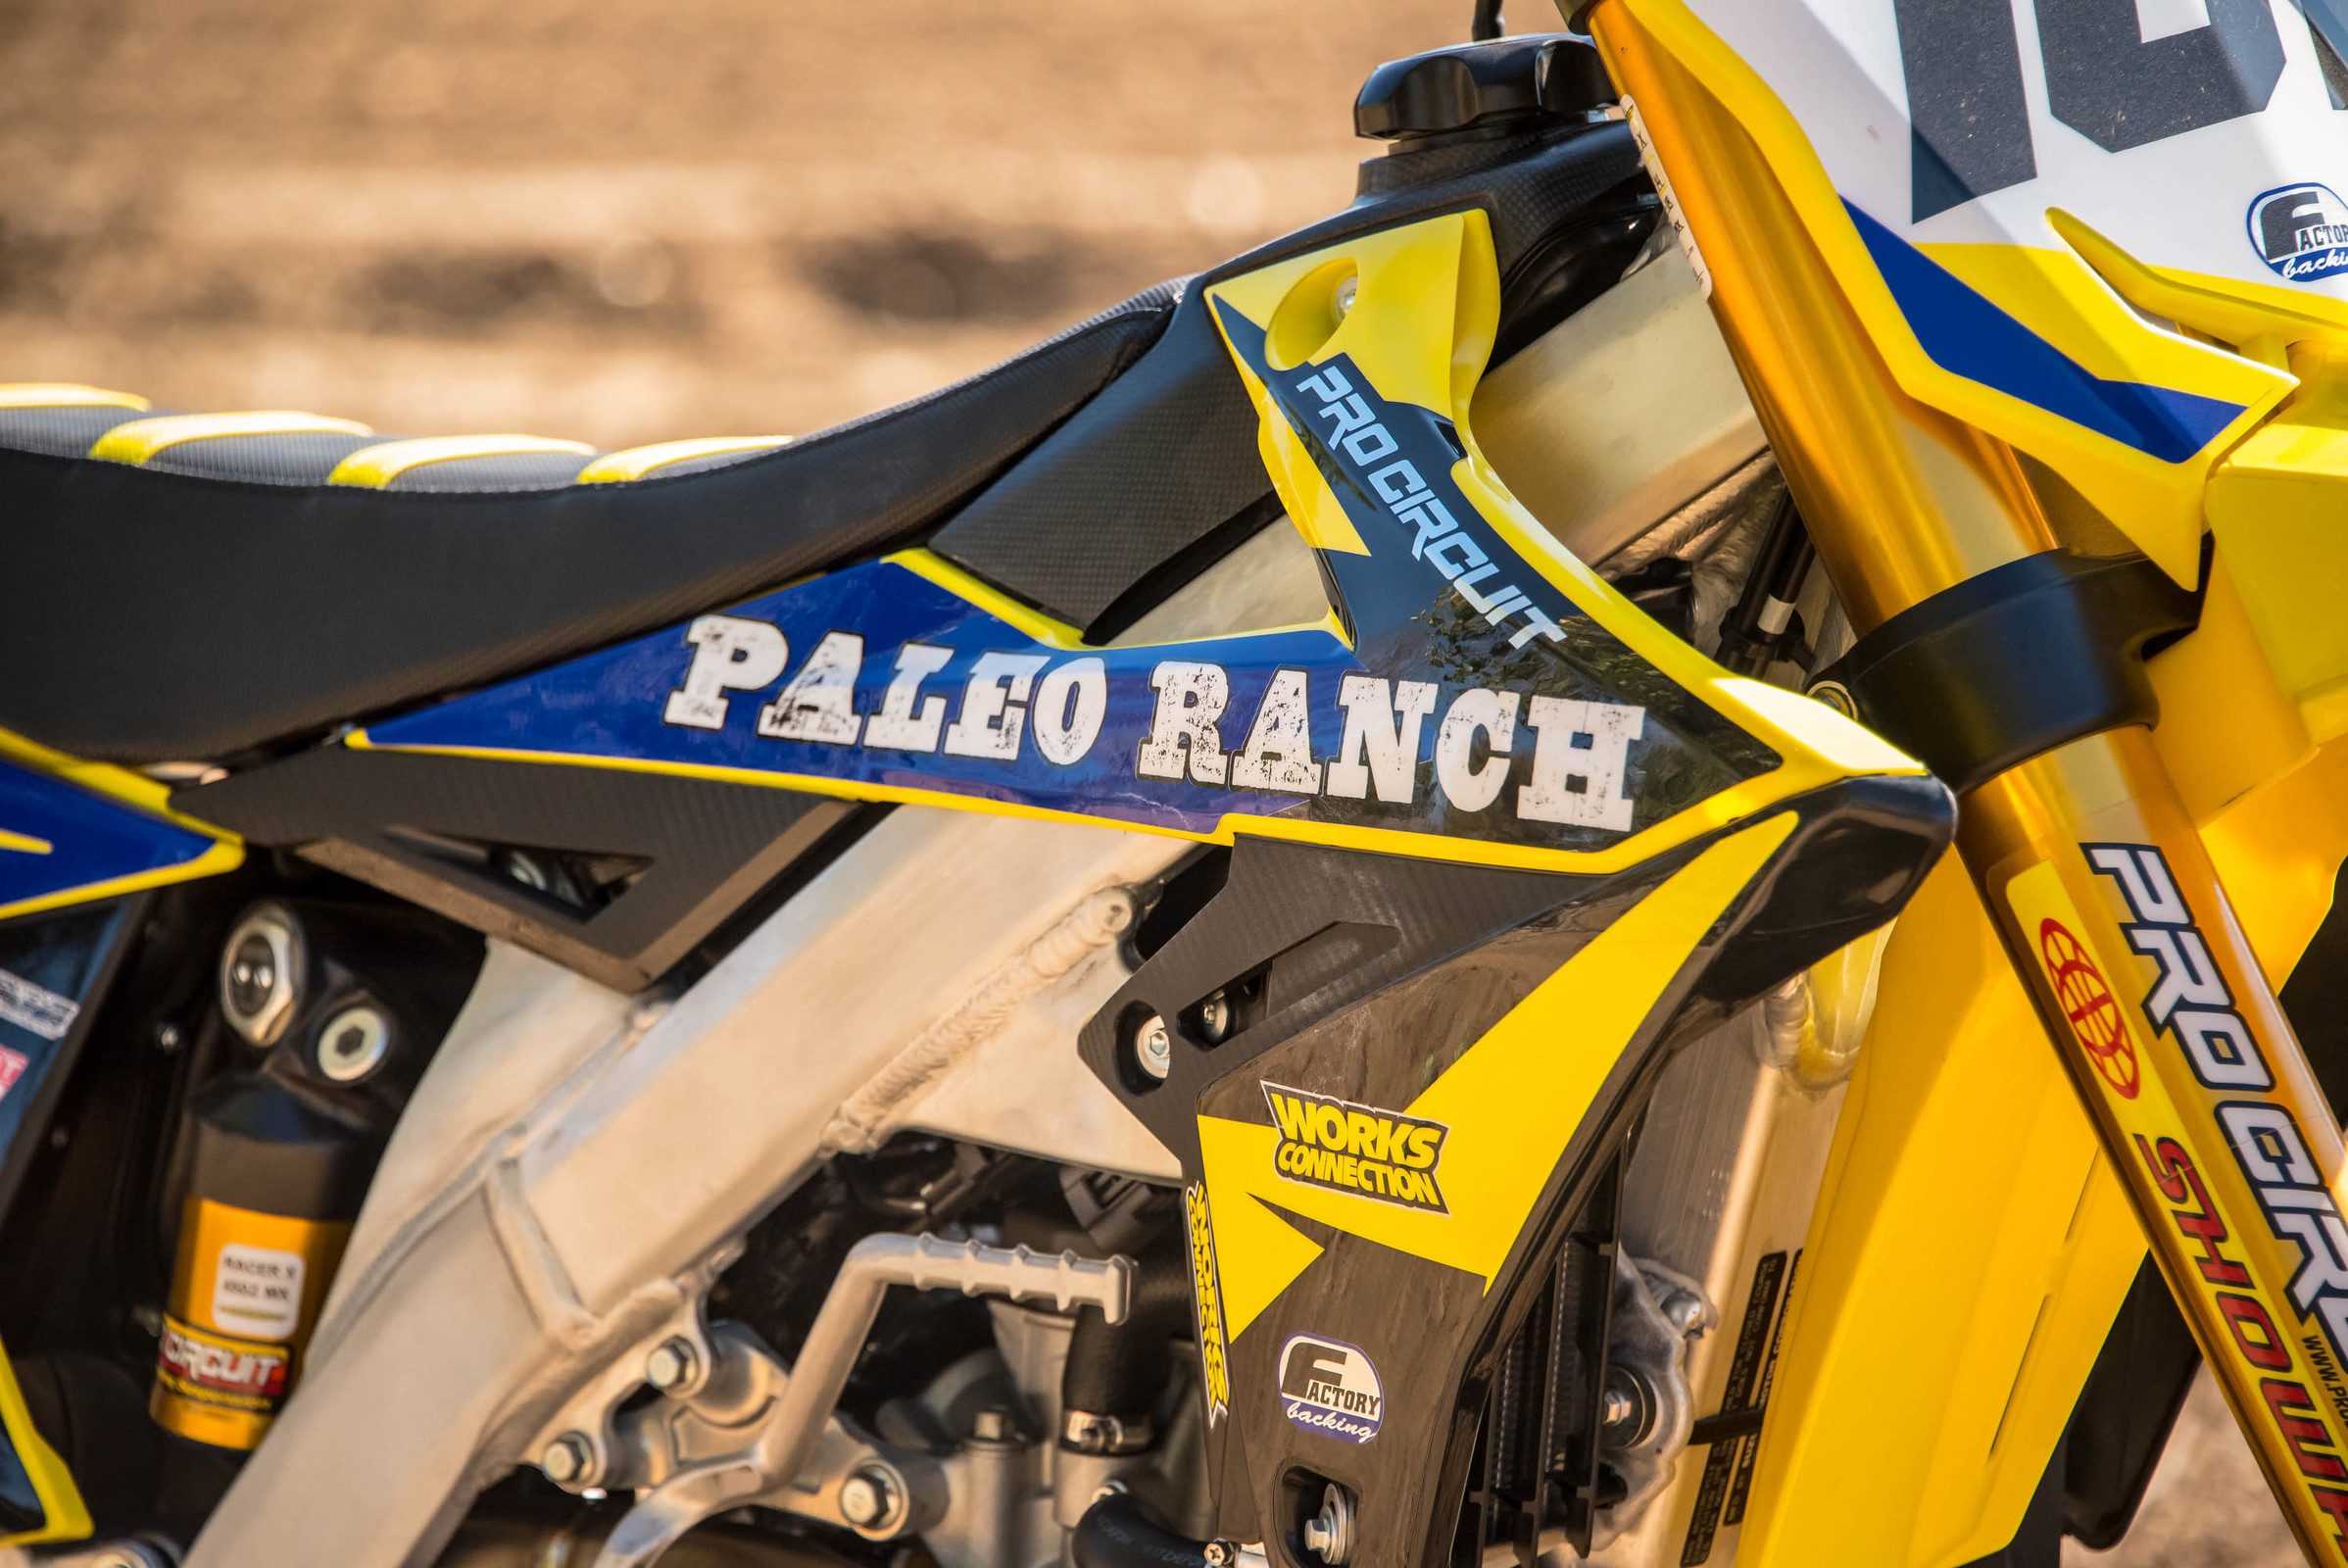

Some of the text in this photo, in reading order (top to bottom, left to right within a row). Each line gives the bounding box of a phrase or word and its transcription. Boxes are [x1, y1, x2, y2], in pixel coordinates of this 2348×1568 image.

[1296, 366, 1568, 650] PRO CIRCUIT
[662, 613, 1646, 833] PALEO RANCH
[2078, 842, 2275, 1093] PRO
[1271, 1092, 1442, 1170] WORKS
[1278, 1143, 1441, 1206] CONNECTION
[1196, 1183, 1228, 1407] WORKS
[1282, 1341, 1381, 1417] FACTORY
[1287, 1401, 1377, 1444] backing
